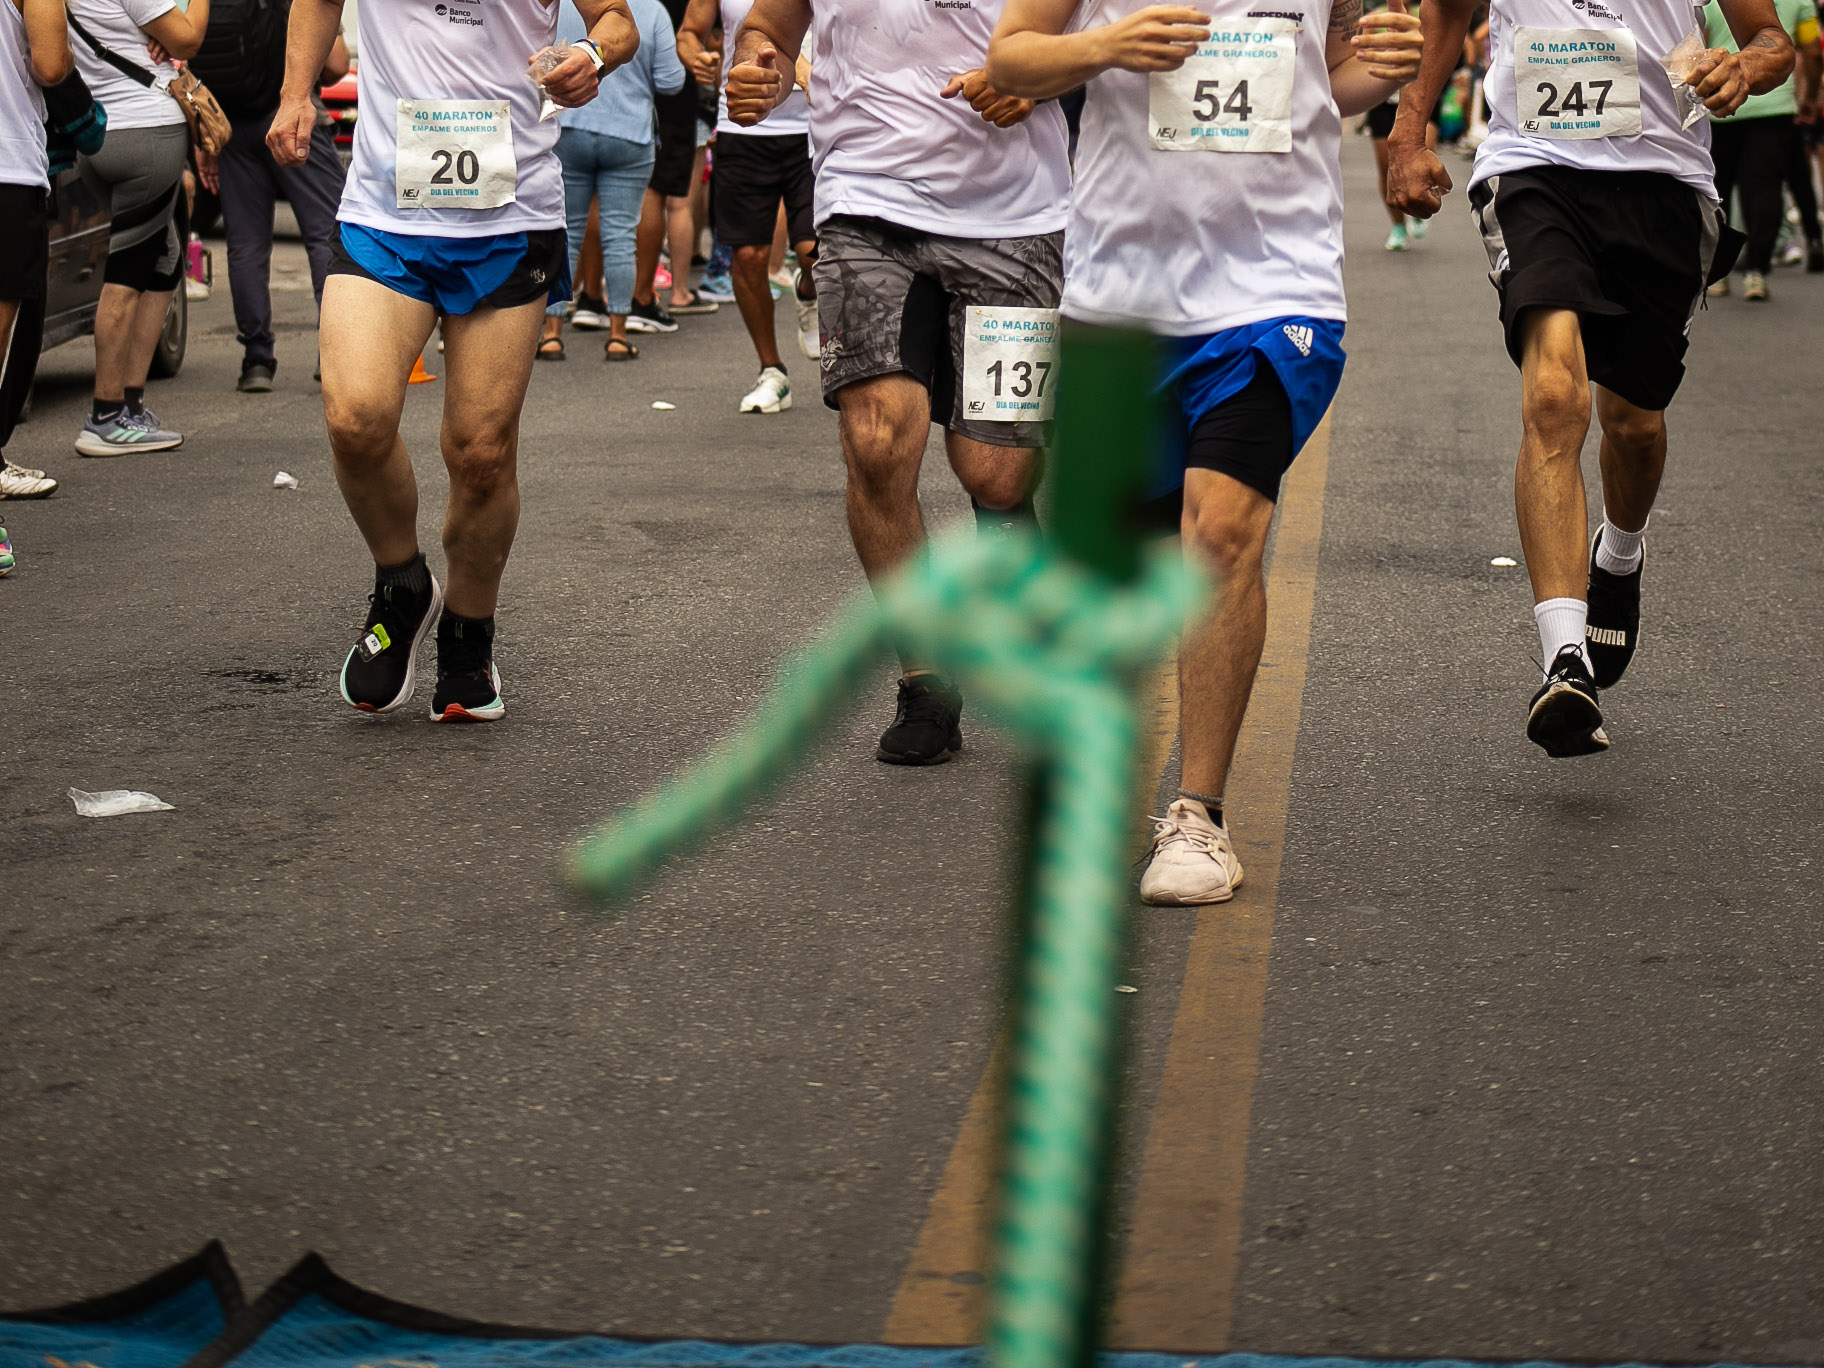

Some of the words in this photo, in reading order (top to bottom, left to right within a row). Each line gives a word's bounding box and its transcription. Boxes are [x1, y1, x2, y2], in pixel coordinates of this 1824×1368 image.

[934, 0, 972, 10] Municipal
[449, 8, 471, 16] Banco
[449, 16, 484, 27] Municipal
[1210, 32, 1273, 43] ARATON
[1530, 42, 1544, 52] 40
[1548, 42, 1616, 52] MARATON
[1223, 50, 1278, 58] GRANEROS
[1528, 56, 1568, 65] EMPALME
[1571, 55, 1622, 64] GRANEROS
[1192, 80, 1252, 122] 54
[1536, 80, 1613, 117] 247
[414, 111, 428, 121] 40
[432, 111, 493, 120] MARATON
[1523, 120, 1540, 131] NEJ
[1550, 121, 1562, 130] DIA
[1562, 121, 1574, 130] DEL
[1576, 120, 1600, 129] VECINO
[1156, 127, 1178, 139] NEJ
[430, 150, 480, 185] 20
[402, 188, 420, 198] NEJ
[430, 188, 442, 196] DIA
[442, 188, 455, 196] DEL
[456, 188, 479, 196] VECINO
[983, 320, 998, 330] 40
[980, 334, 1022, 343] EMPALME
[1283, 325, 1310, 357] adidas
[986, 360, 1052, 398] 137
[968, 401, 986, 411] NEJ
[996, 401, 1008, 409] DIA
[1008, 401, 1020, 410] DEL
